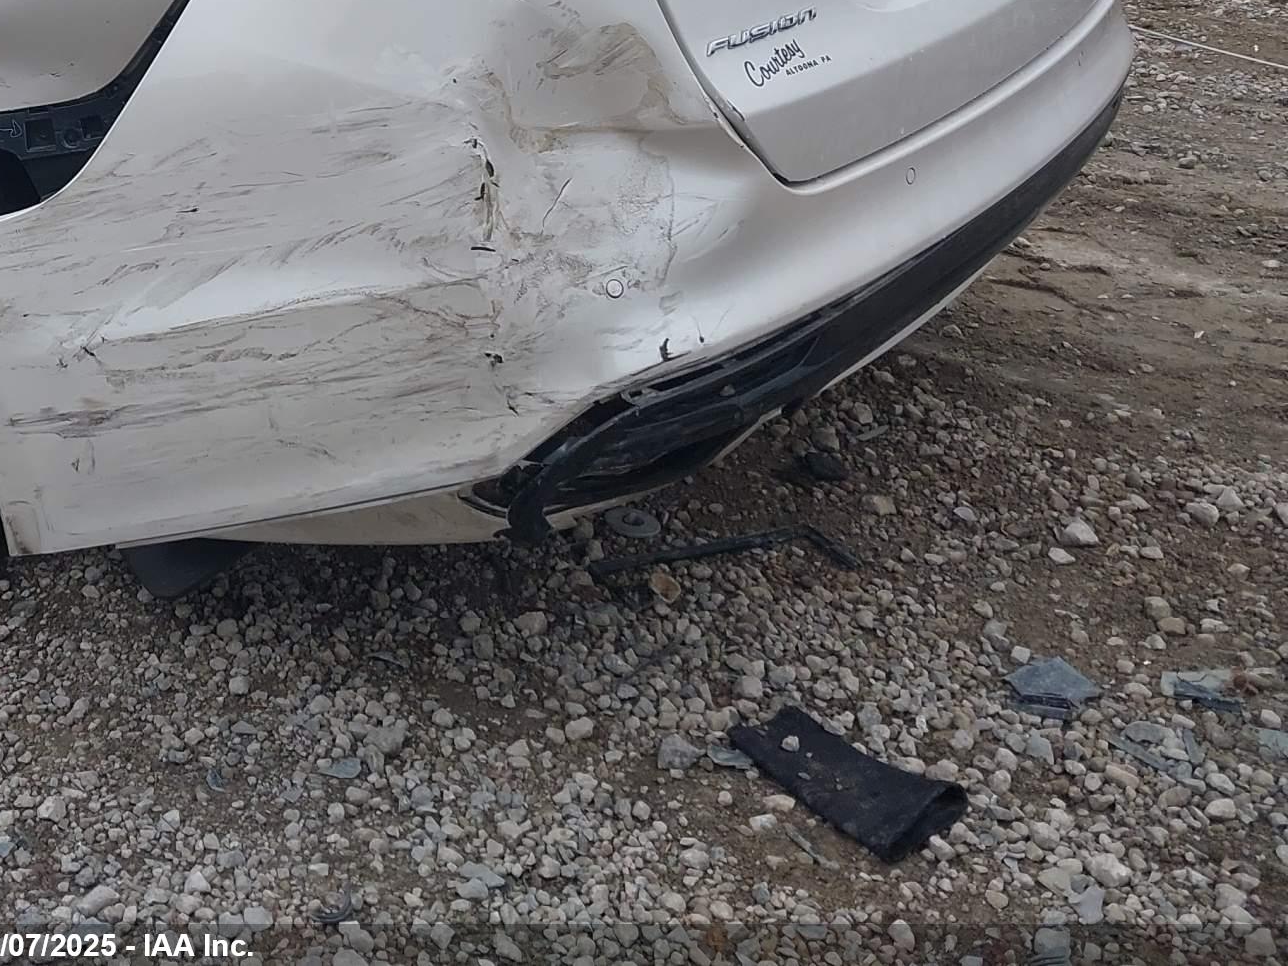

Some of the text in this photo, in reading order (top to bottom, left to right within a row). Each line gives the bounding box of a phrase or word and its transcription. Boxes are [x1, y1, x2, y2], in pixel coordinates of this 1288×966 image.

[706, 5, 817, 57] FUSION
[744, 39, 805, 87] Courtesy
[785, 54, 832, 76] ALTOONA PA
